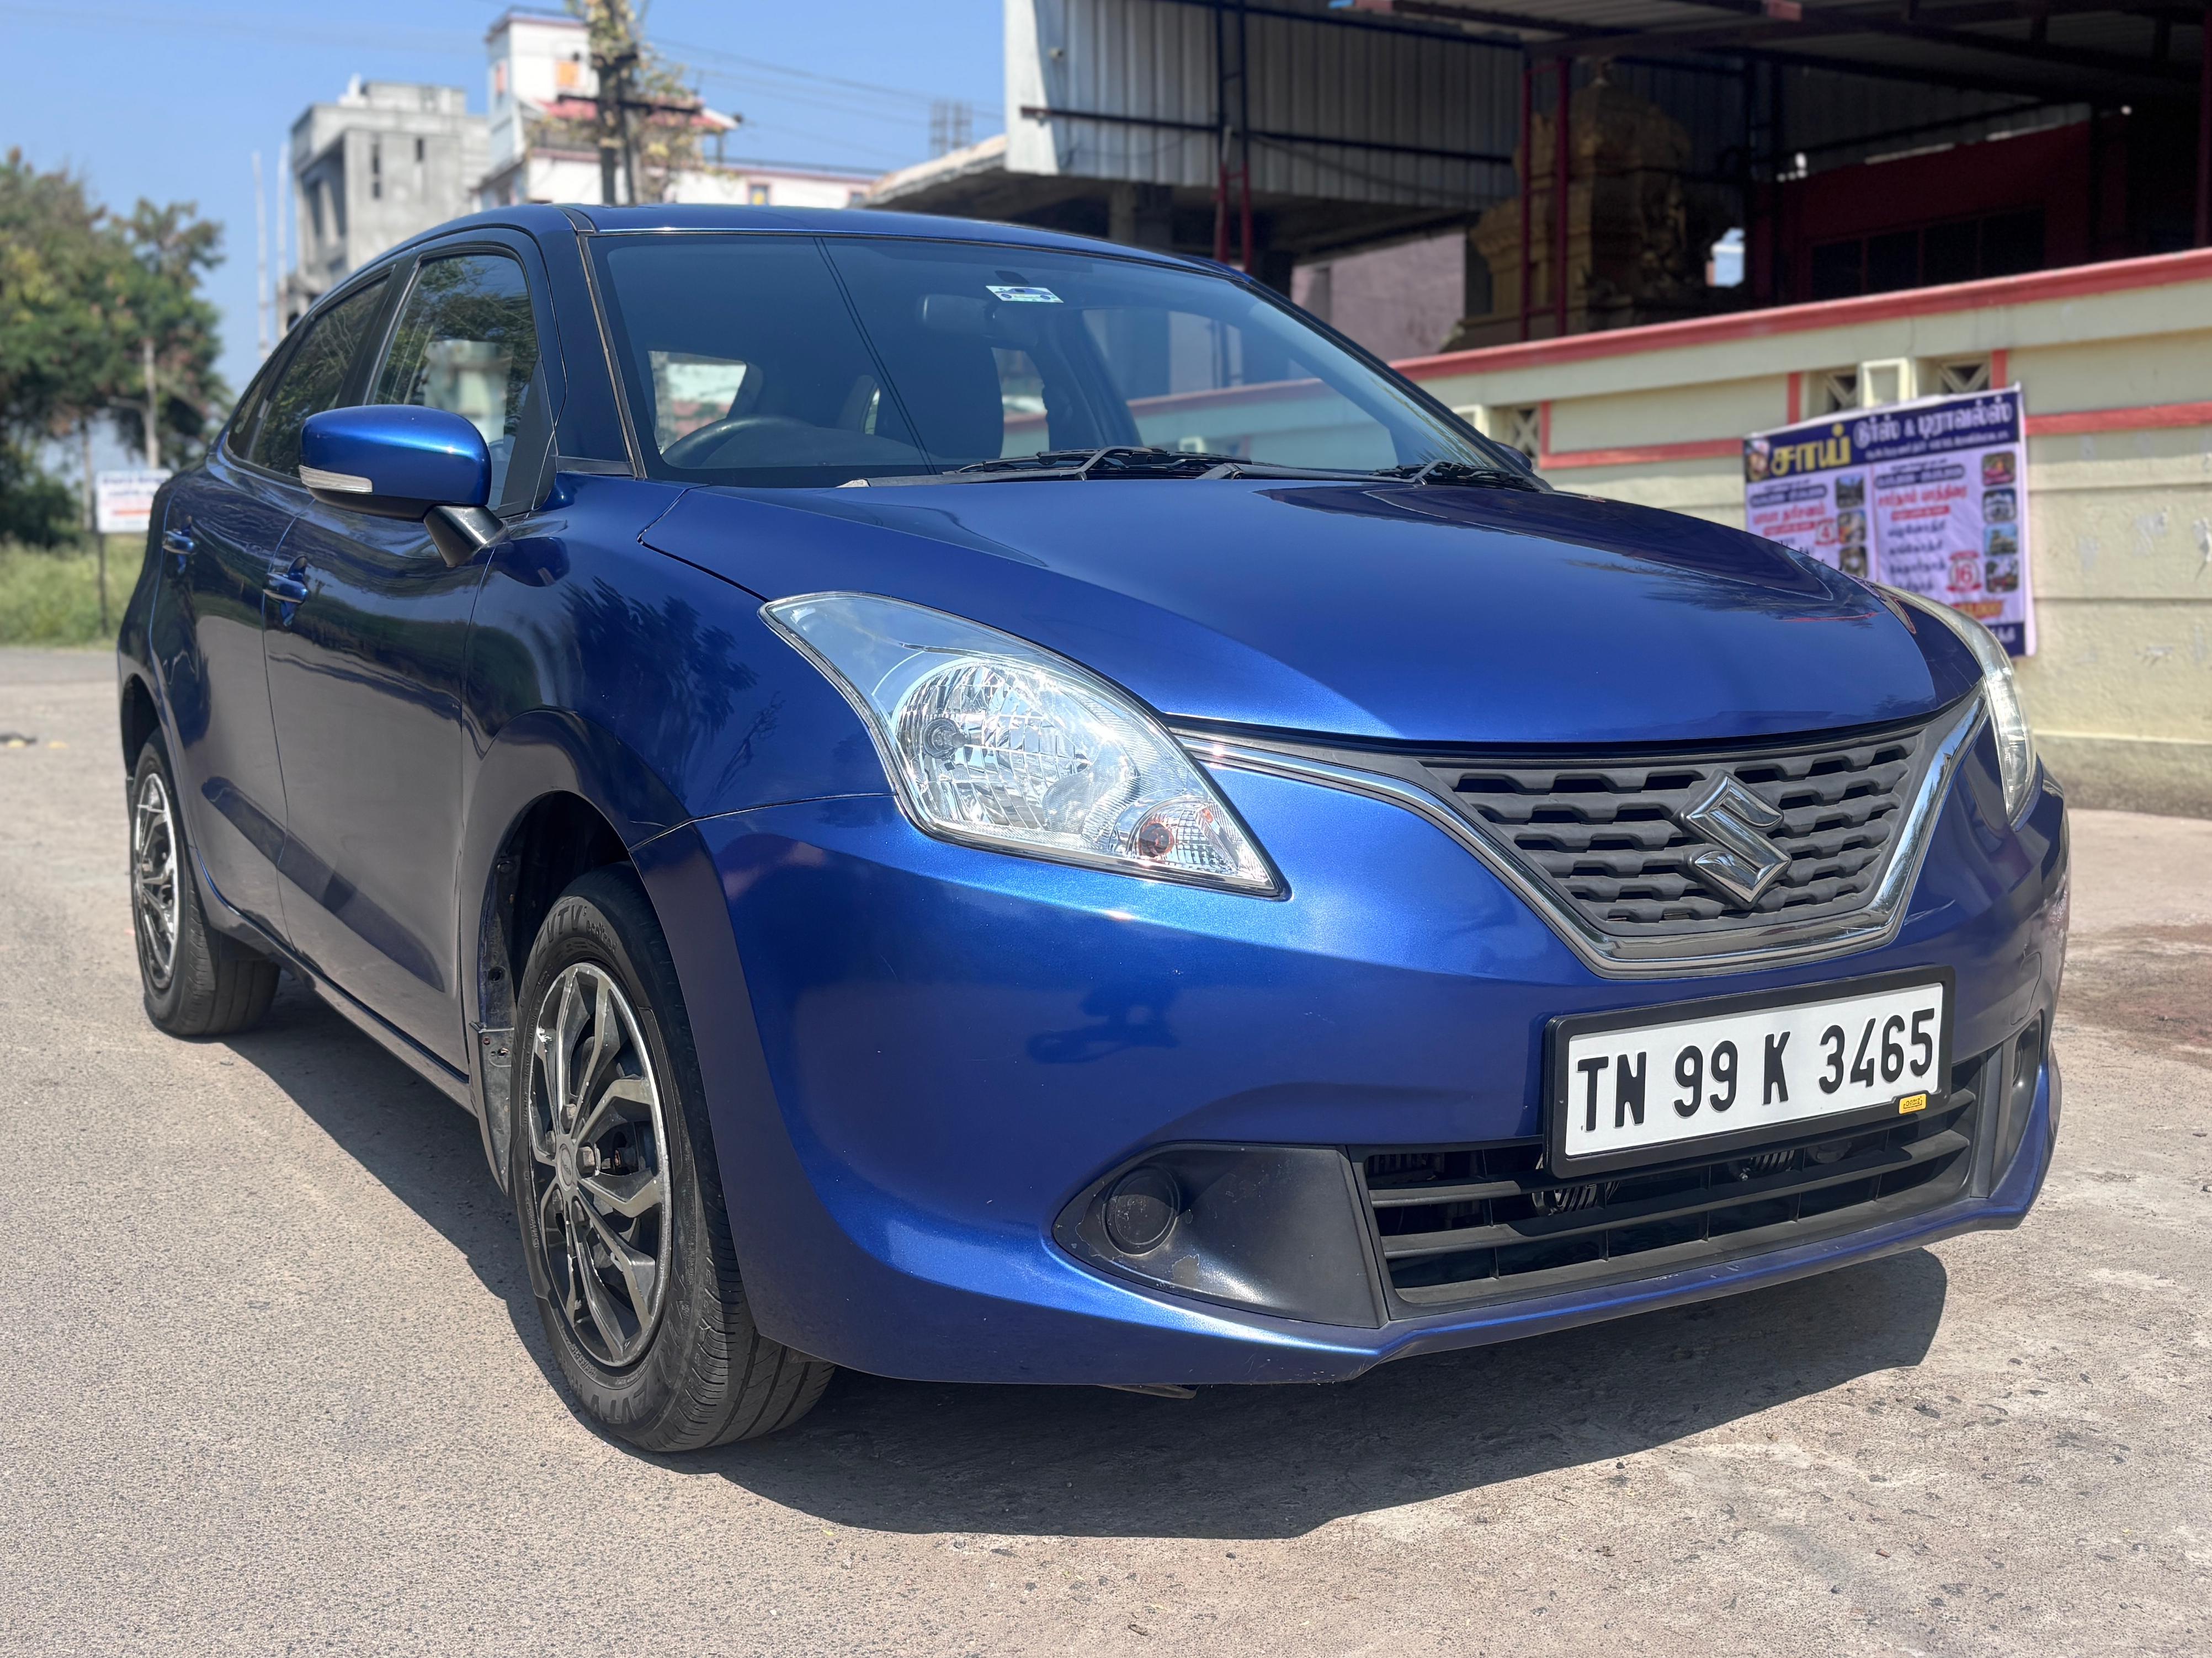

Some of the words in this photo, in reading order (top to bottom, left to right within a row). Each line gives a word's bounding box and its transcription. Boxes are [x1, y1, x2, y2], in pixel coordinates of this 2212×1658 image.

[1770, 423, 1851, 476] சாய்
[1954, 564, 1972, 585] 16
[1577, 1051, 1647, 1132] TN
[1673, 1040, 1738, 1118] 99
[1762, 1030, 1791, 1106] K
[1818, 1007, 1936, 1095] 3465
